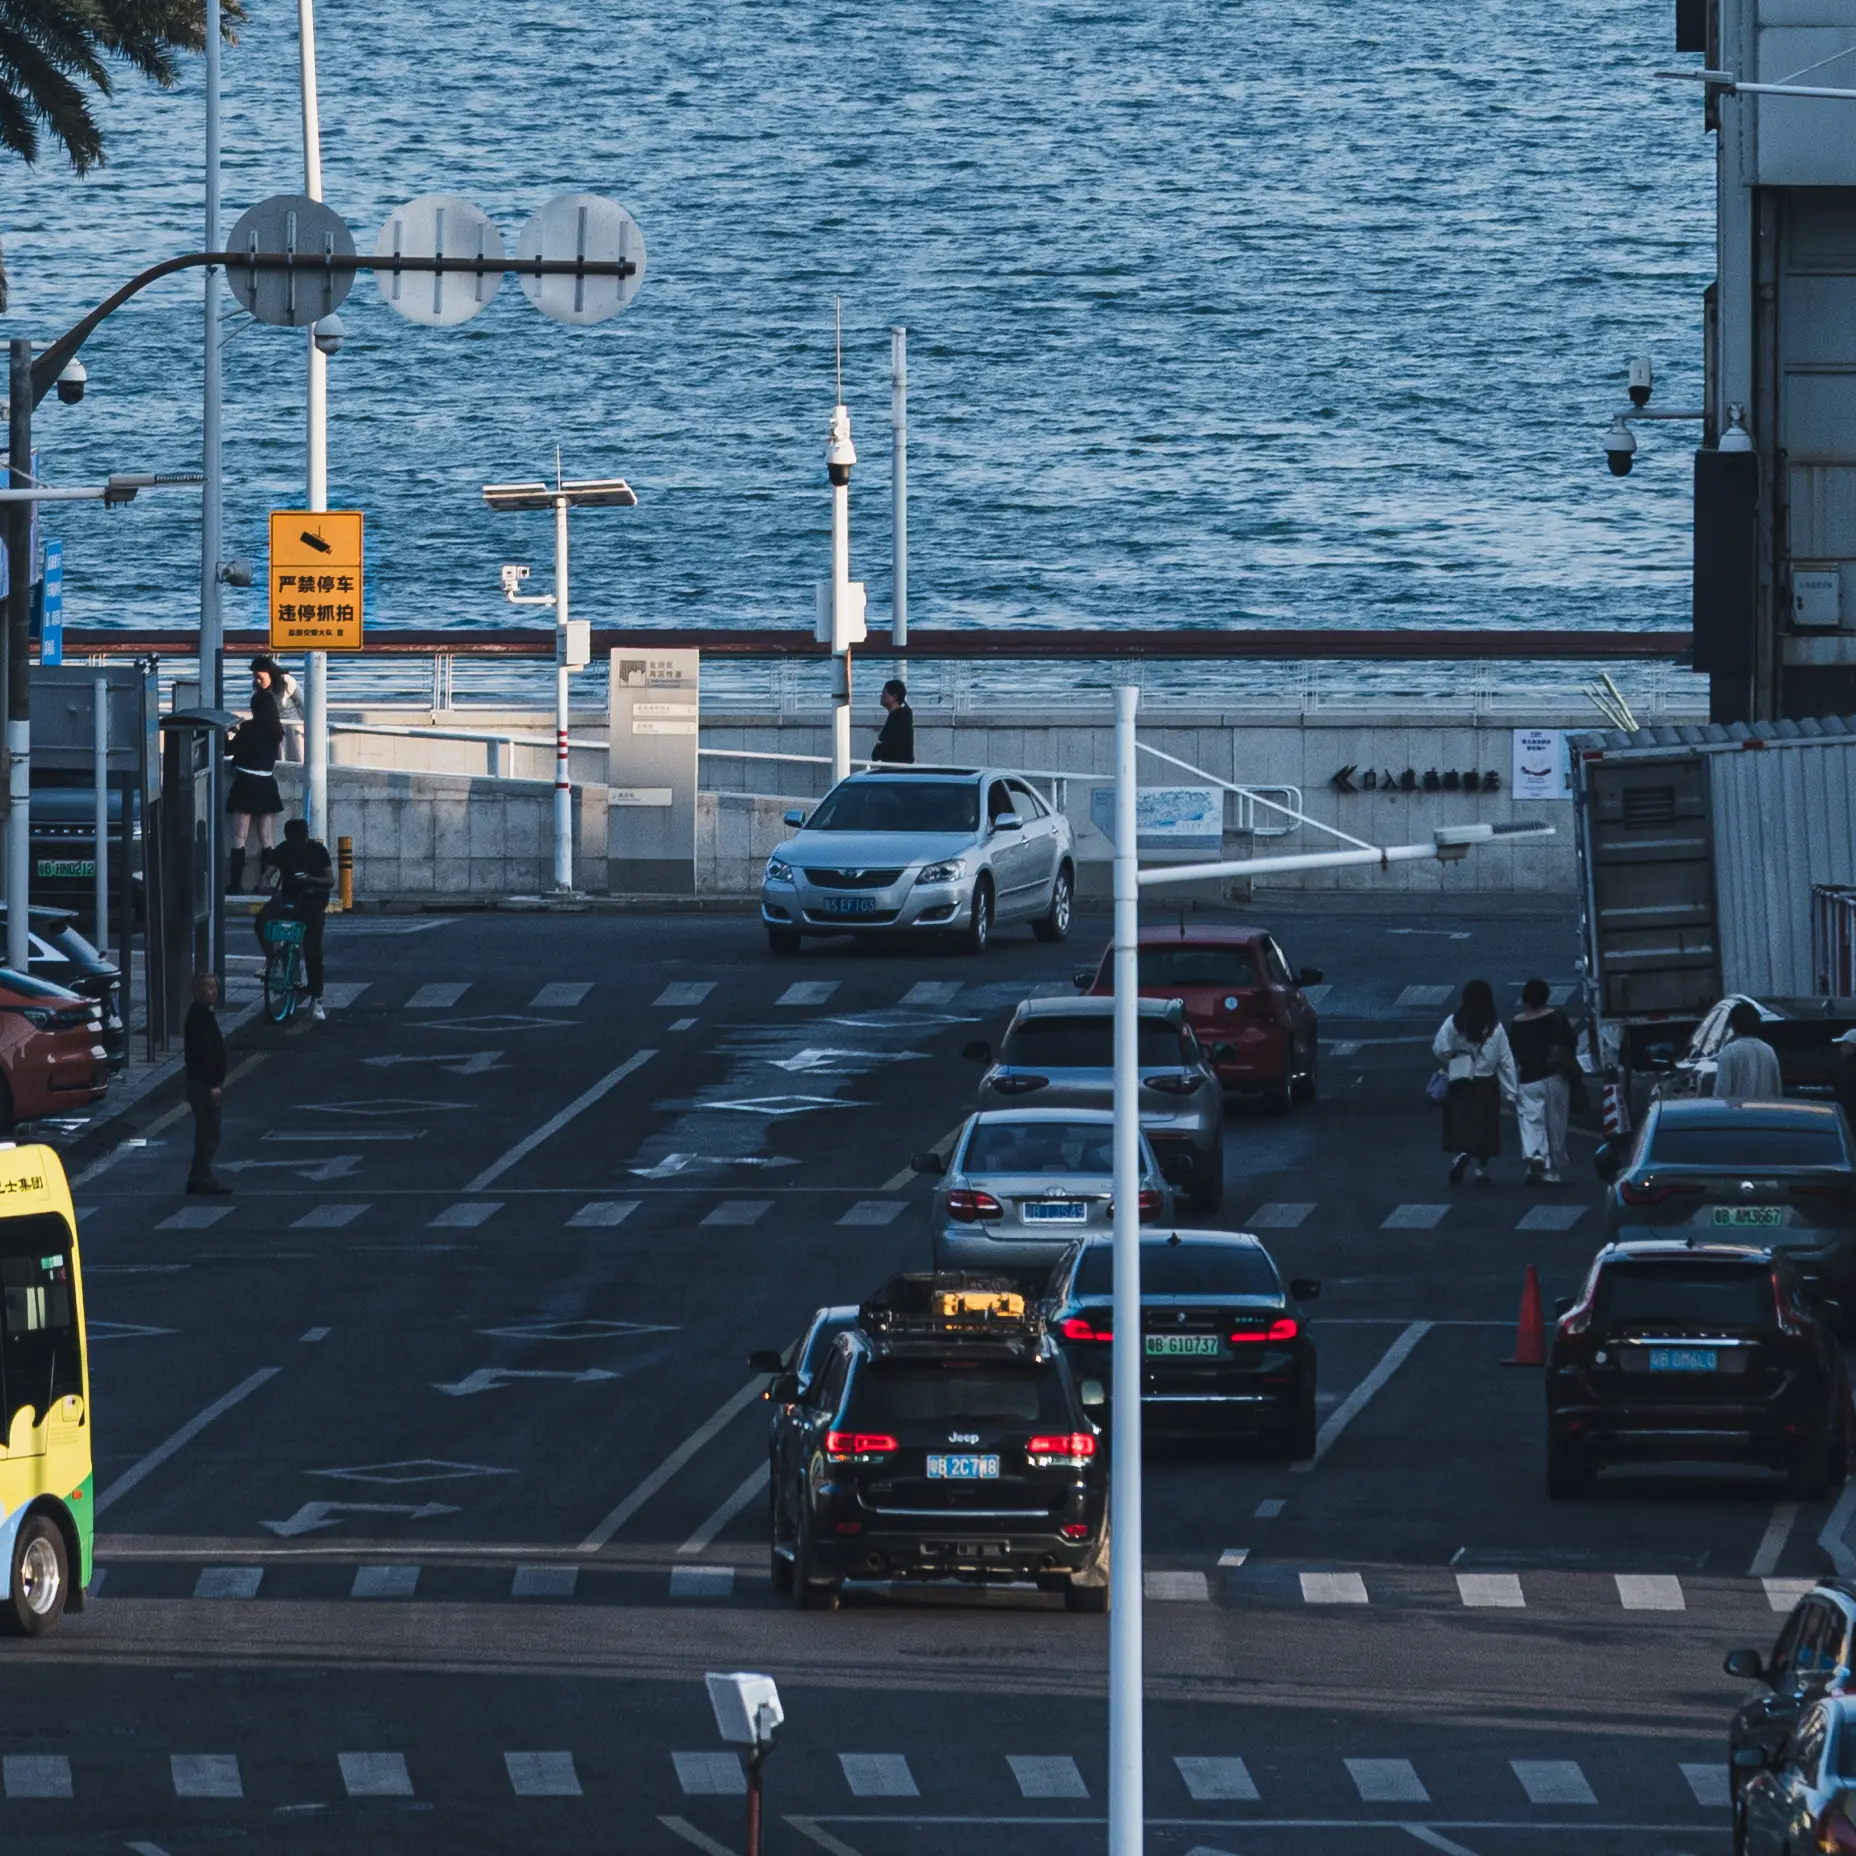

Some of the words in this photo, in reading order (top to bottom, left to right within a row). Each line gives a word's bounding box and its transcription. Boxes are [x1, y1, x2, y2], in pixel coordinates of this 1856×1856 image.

[278, 575, 354, 593] 严禁停车
[278, 604, 354, 622] 违停抓拍
[948, 1432, 979, 1444] Jeep
